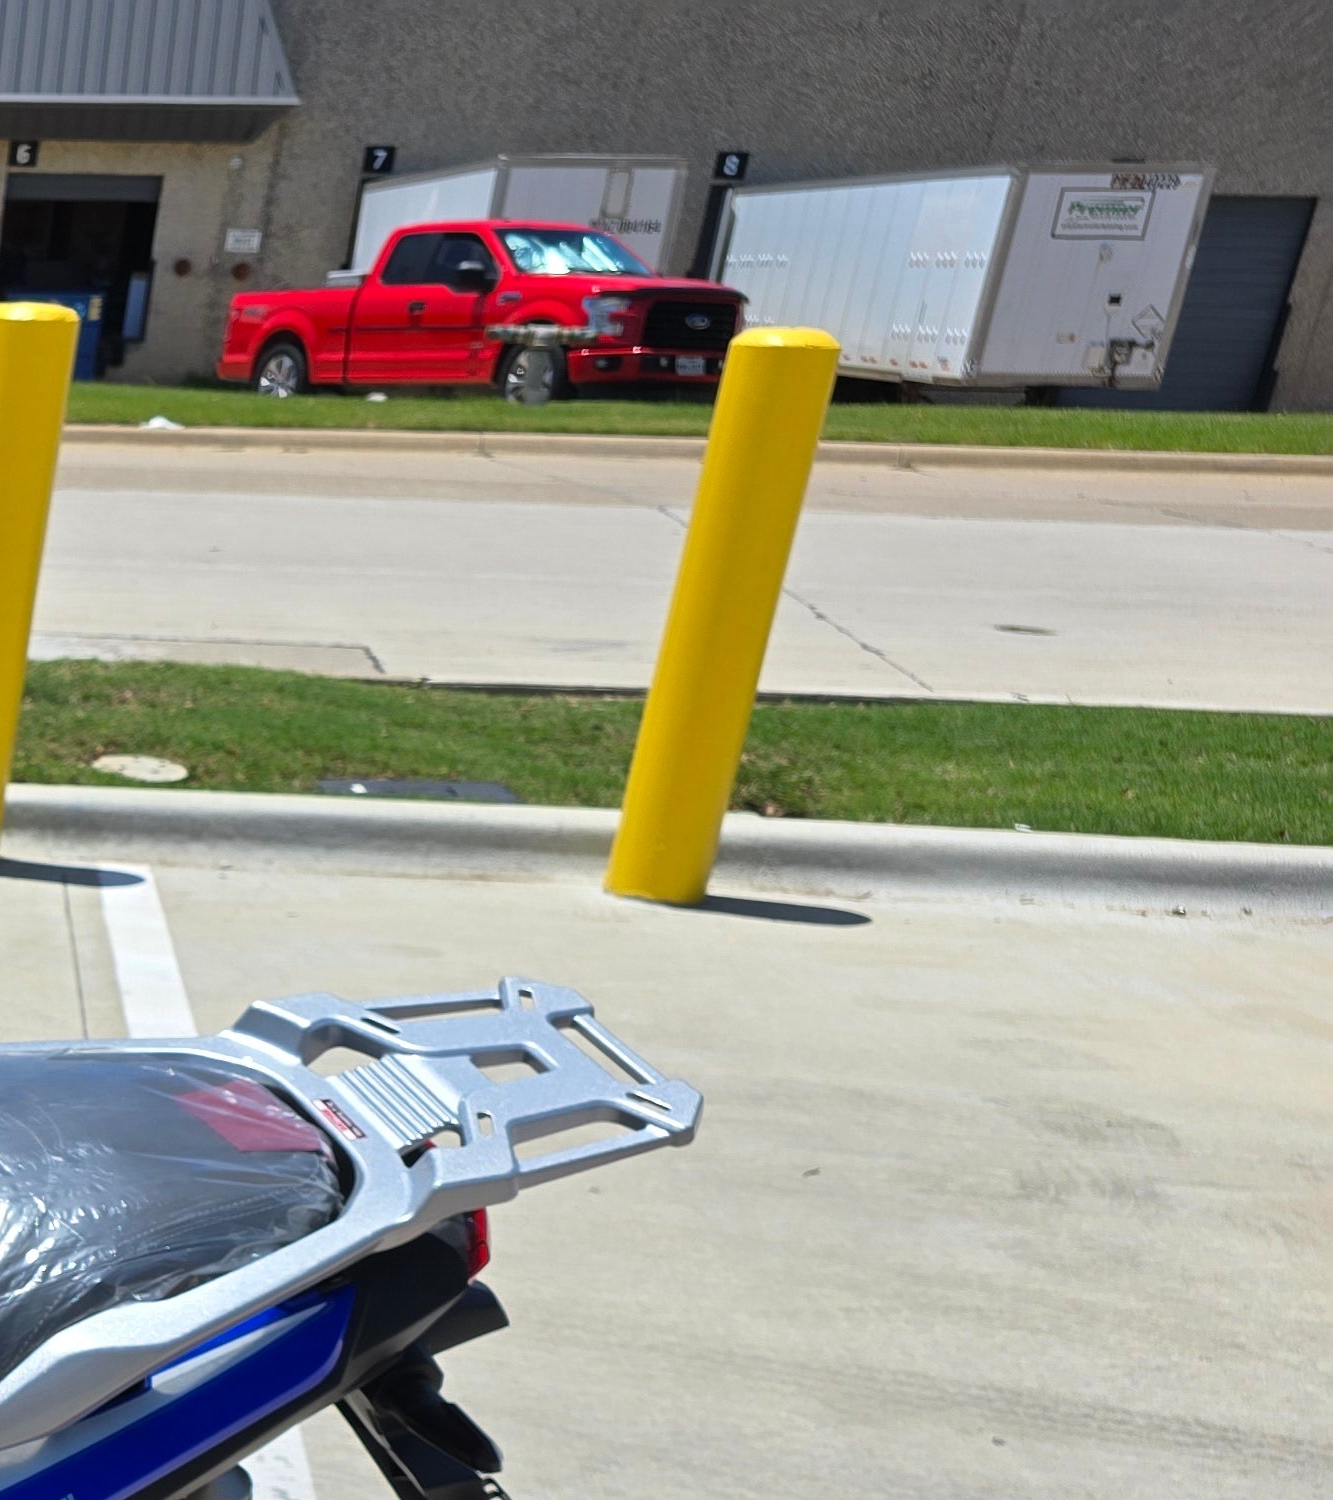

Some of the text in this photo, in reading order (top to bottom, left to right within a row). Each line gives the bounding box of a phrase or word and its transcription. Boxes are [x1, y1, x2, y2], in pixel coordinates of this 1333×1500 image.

[16, 144, 32, 164] 6
[373, 149, 388, 169] 7
[724, 155, 740, 176] 8
